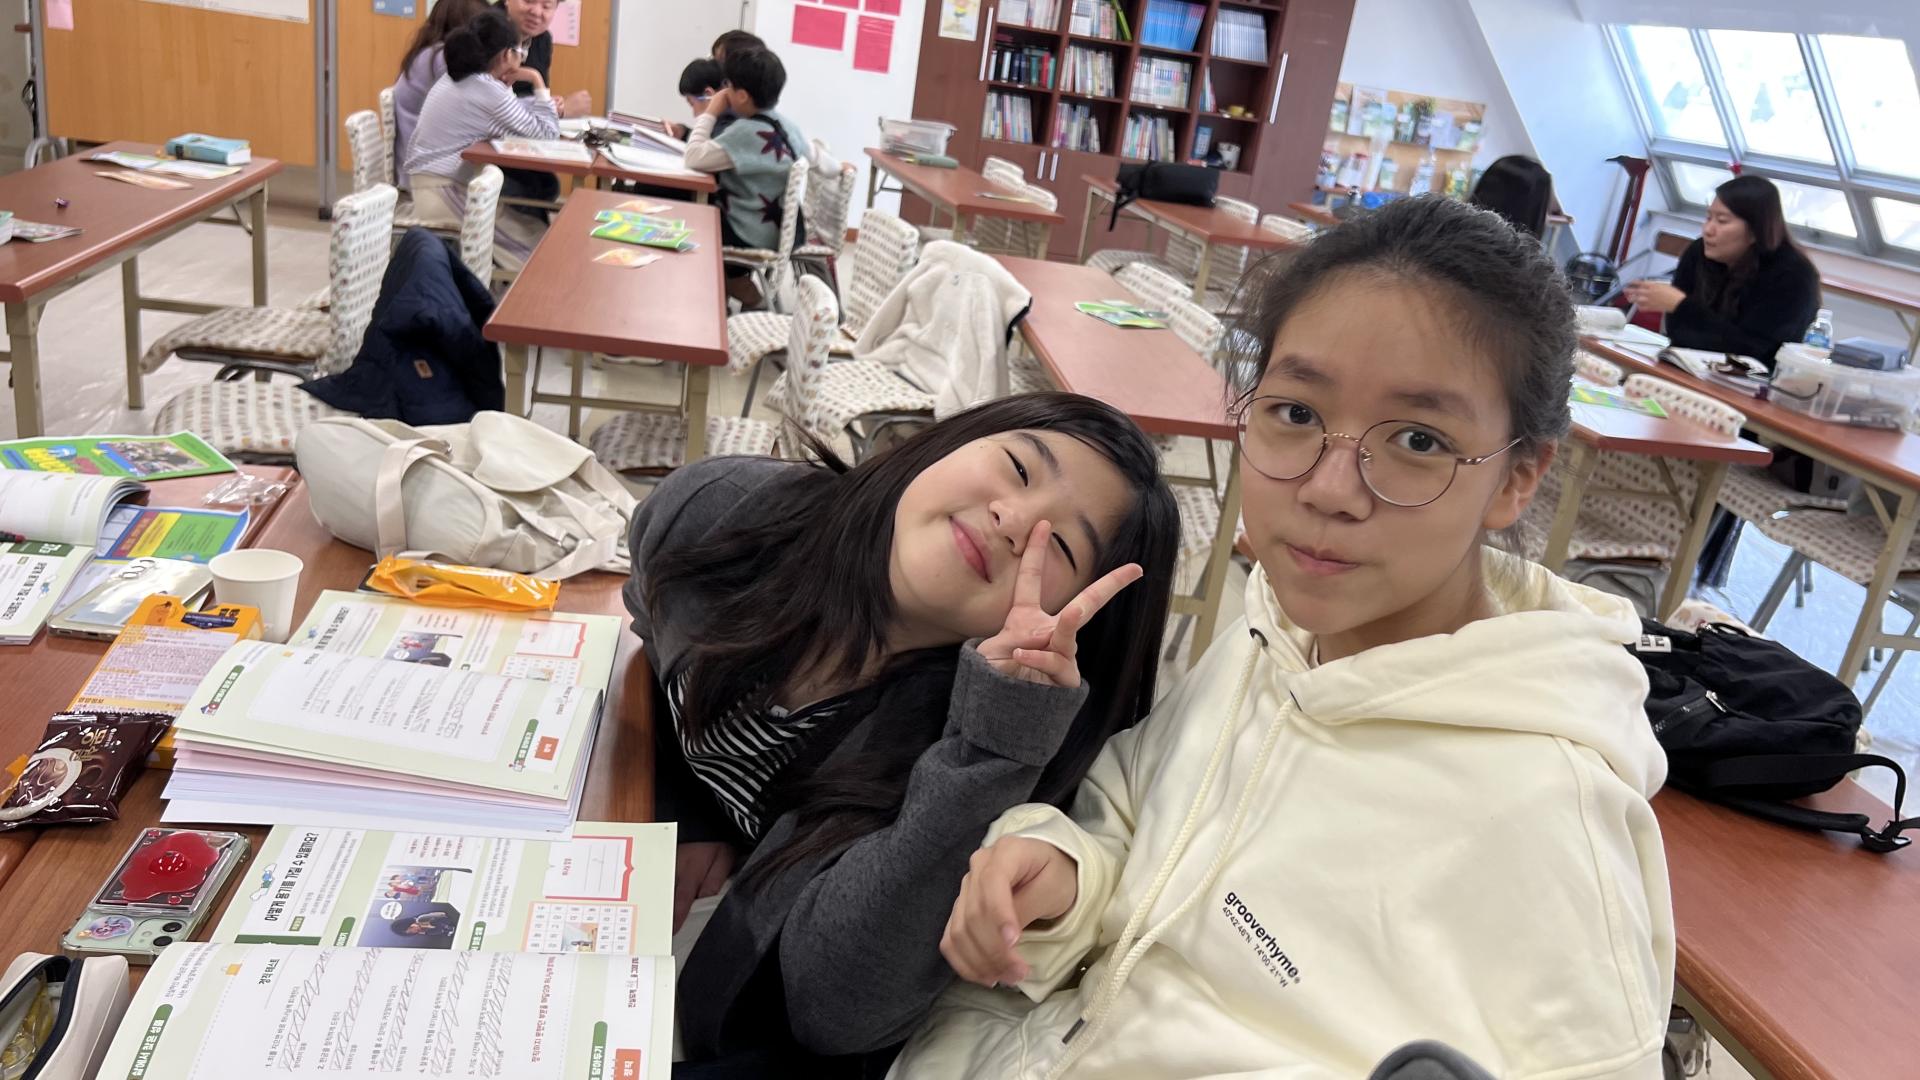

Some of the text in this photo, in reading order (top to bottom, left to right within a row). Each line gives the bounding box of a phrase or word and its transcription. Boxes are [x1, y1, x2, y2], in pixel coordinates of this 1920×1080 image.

[294, 832, 319, 858] 있을까요?
[284, 867, 302, 879] 가질
[274, 880, 296, 899] 용기를
[264, 900, 285, 920] 어떻게
[258, 958, 280, 984] 정직 테스트
[622, 1060, 634, 1076] 정직
